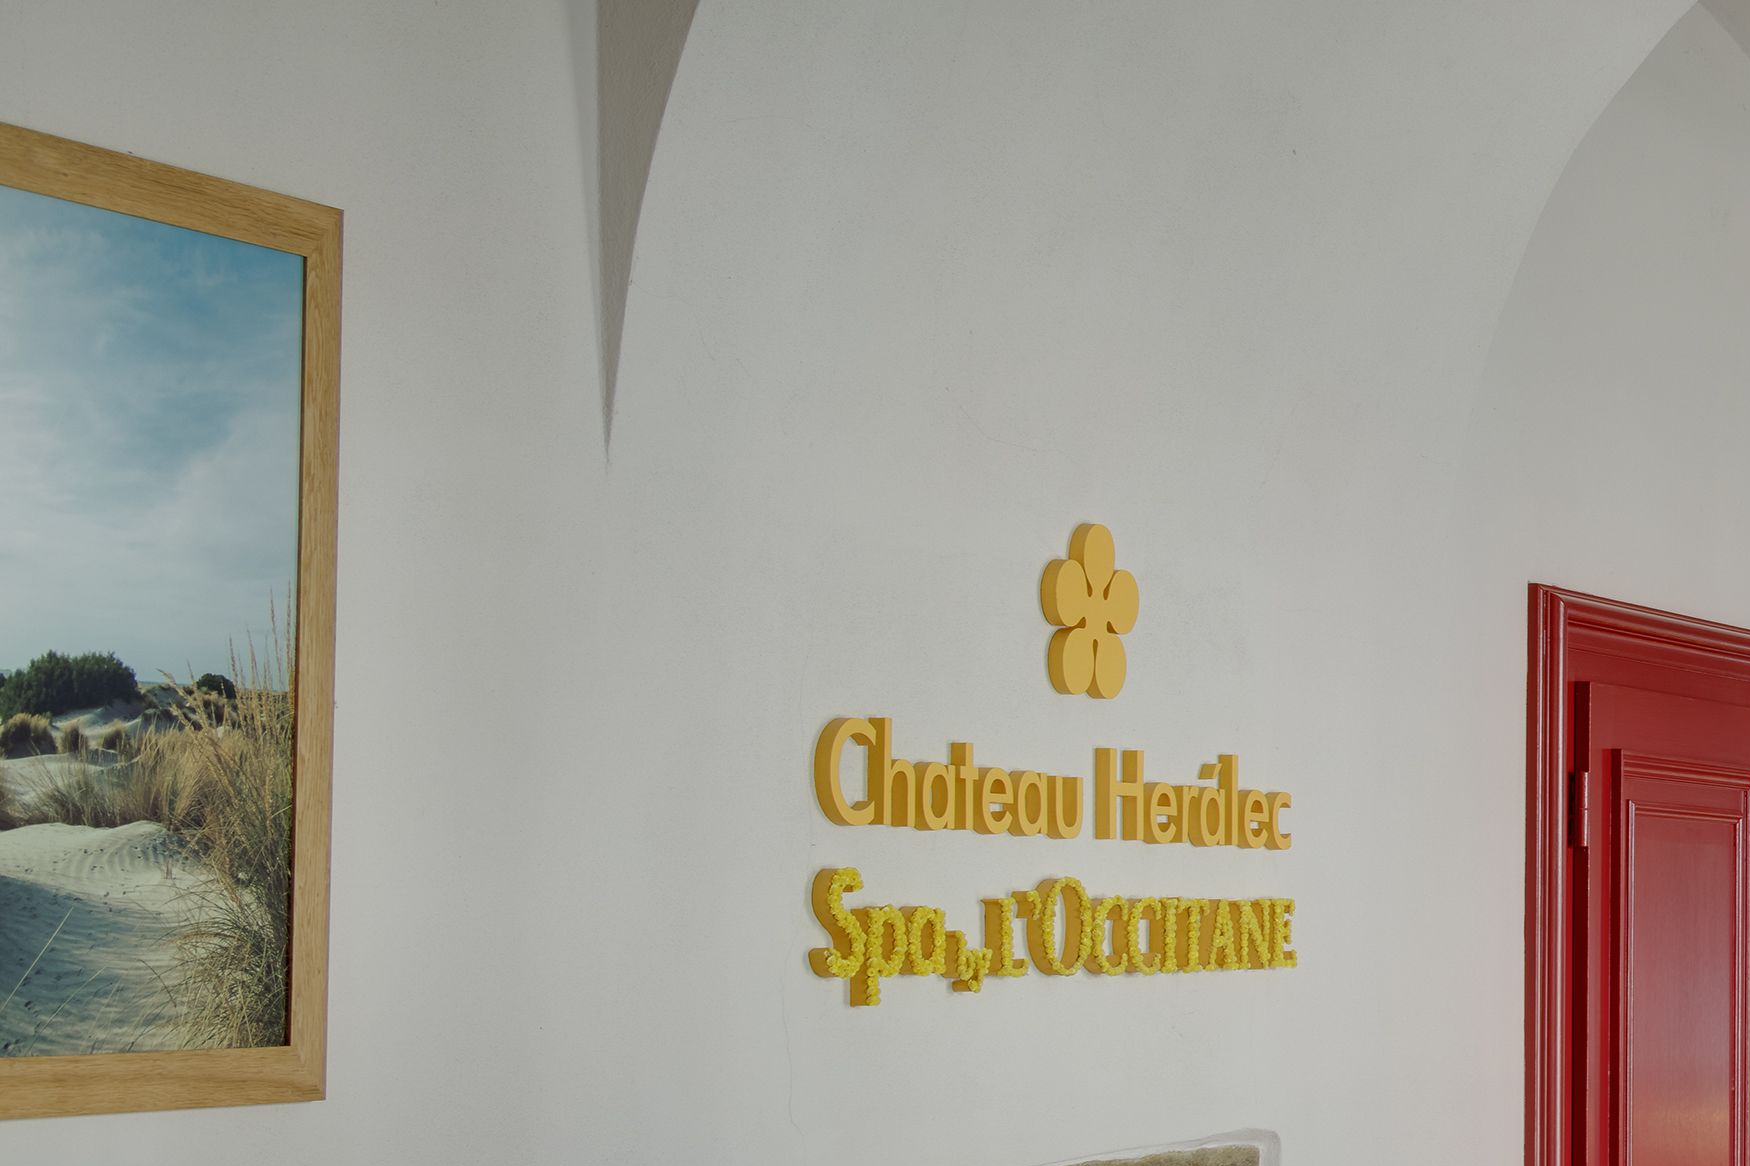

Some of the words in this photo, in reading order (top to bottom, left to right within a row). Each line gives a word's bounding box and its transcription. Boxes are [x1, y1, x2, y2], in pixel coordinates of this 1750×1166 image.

[814, 717, 1084, 839] Chateau
[1094, 747, 1293, 850] Herálec
[809, 867, 946, 1007] Spa
